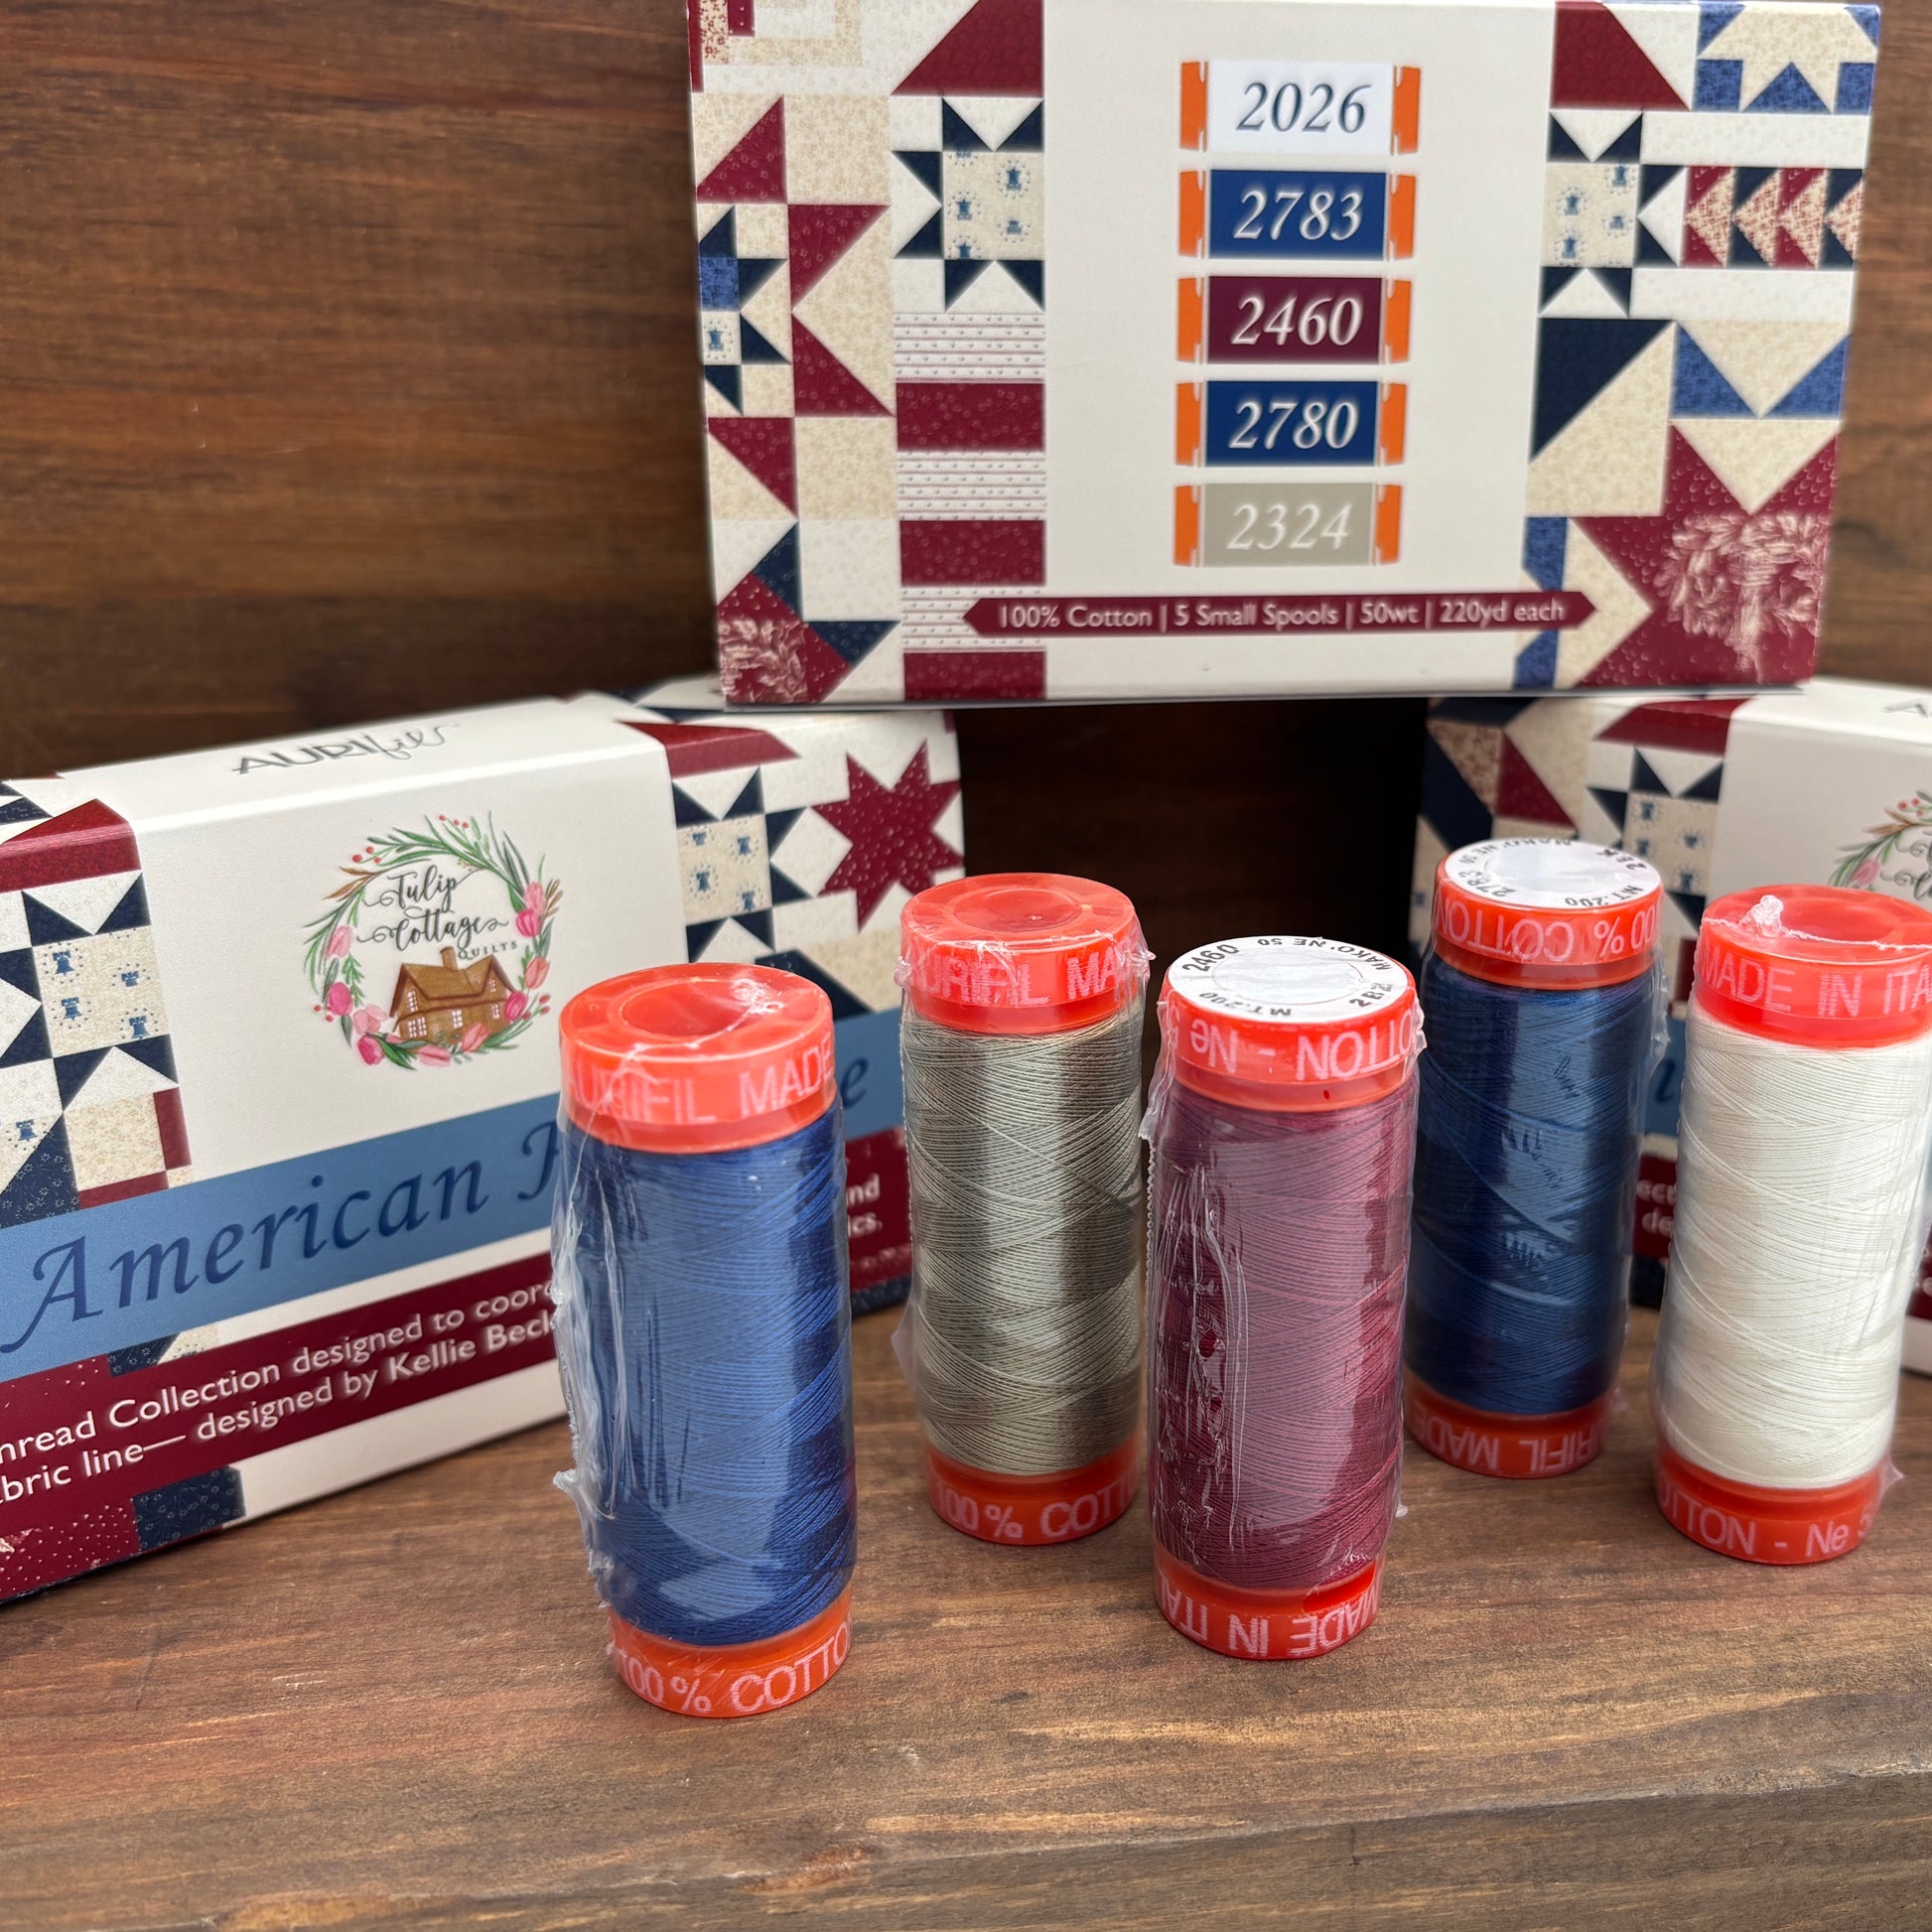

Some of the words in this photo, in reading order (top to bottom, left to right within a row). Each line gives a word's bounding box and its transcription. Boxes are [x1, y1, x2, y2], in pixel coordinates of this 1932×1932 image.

[1236, 81, 1373, 134] 2026
[1233, 190, 1363, 241] 2783
[1231, 296, 1363, 346] 2460
[1228, 401, 1358, 450] 2780
[1226, 503, 1351, 551] 2324
[999, 604, 1060, 628] 100%
[1066, 604, 1153, 628] Cotton
[1173, 603, 1190, 627] 5
[1194, 602, 1258, 627] Small
[1262, 601, 1339, 632] Spools
[1359, 601, 1421, 624] 50wt
[1439, 598, 1508, 630] 220yd
[1513, 597, 1566, 622] each
[362, 864, 481, 915] Tulip
[1458, 870, 1518, 898] 2783
[356, 905, 508, 951] Cottage
[458, 940, 518, 960] QUILTS
[1257, 937, 1283, 947] 50
[1181, 943, 1241, 974] 2460
[1701, 941, 1796, 1013] MADE
[1817, 971, 1863, 1018] IN
[1189, 1018, 1241, 1074] Ne
[739, 1031, 832, 1118] MADE
[0, 1159, 489, 1352] American
[109, 1360, 281, 1428] Collection
[293, 1310, 424, 1376] designed
[432, 1308, 465, 1345] to
[0, 1464, 71, 1504] bric
[197, 1372, 333, 1441] designed
[343, 1364, 379, 1402] by
[388, 1335, 477, 1383] Kellie
[1805, 1522, 1850, 1558] Ne
[1227, 1613, 1270, 1657] IN
[1286, 1587, 1378, 1657] MADE
[729, 1612, 852, 1714] COTTO
